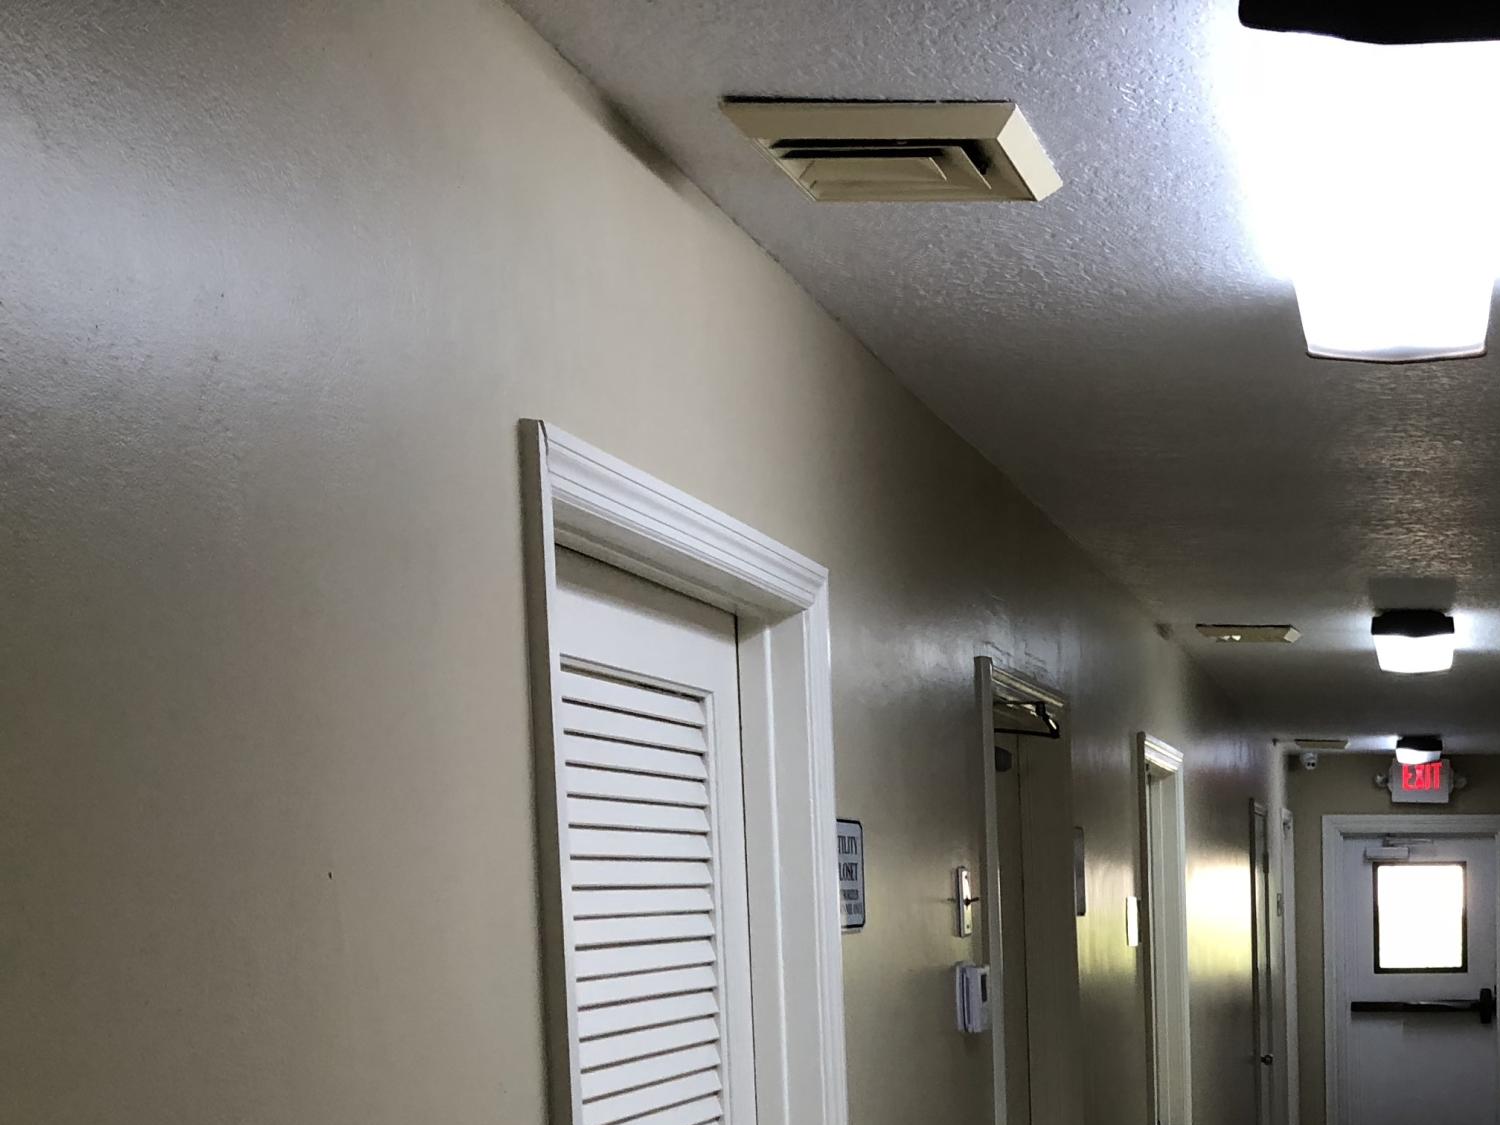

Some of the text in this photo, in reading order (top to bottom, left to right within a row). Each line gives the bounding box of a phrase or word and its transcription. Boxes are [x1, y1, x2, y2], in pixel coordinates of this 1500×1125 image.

[1402, 761, 1442, 791] EXIT
[837, 835, 858, 854] TILITY
[838, 862, 858, 881] LOSET
